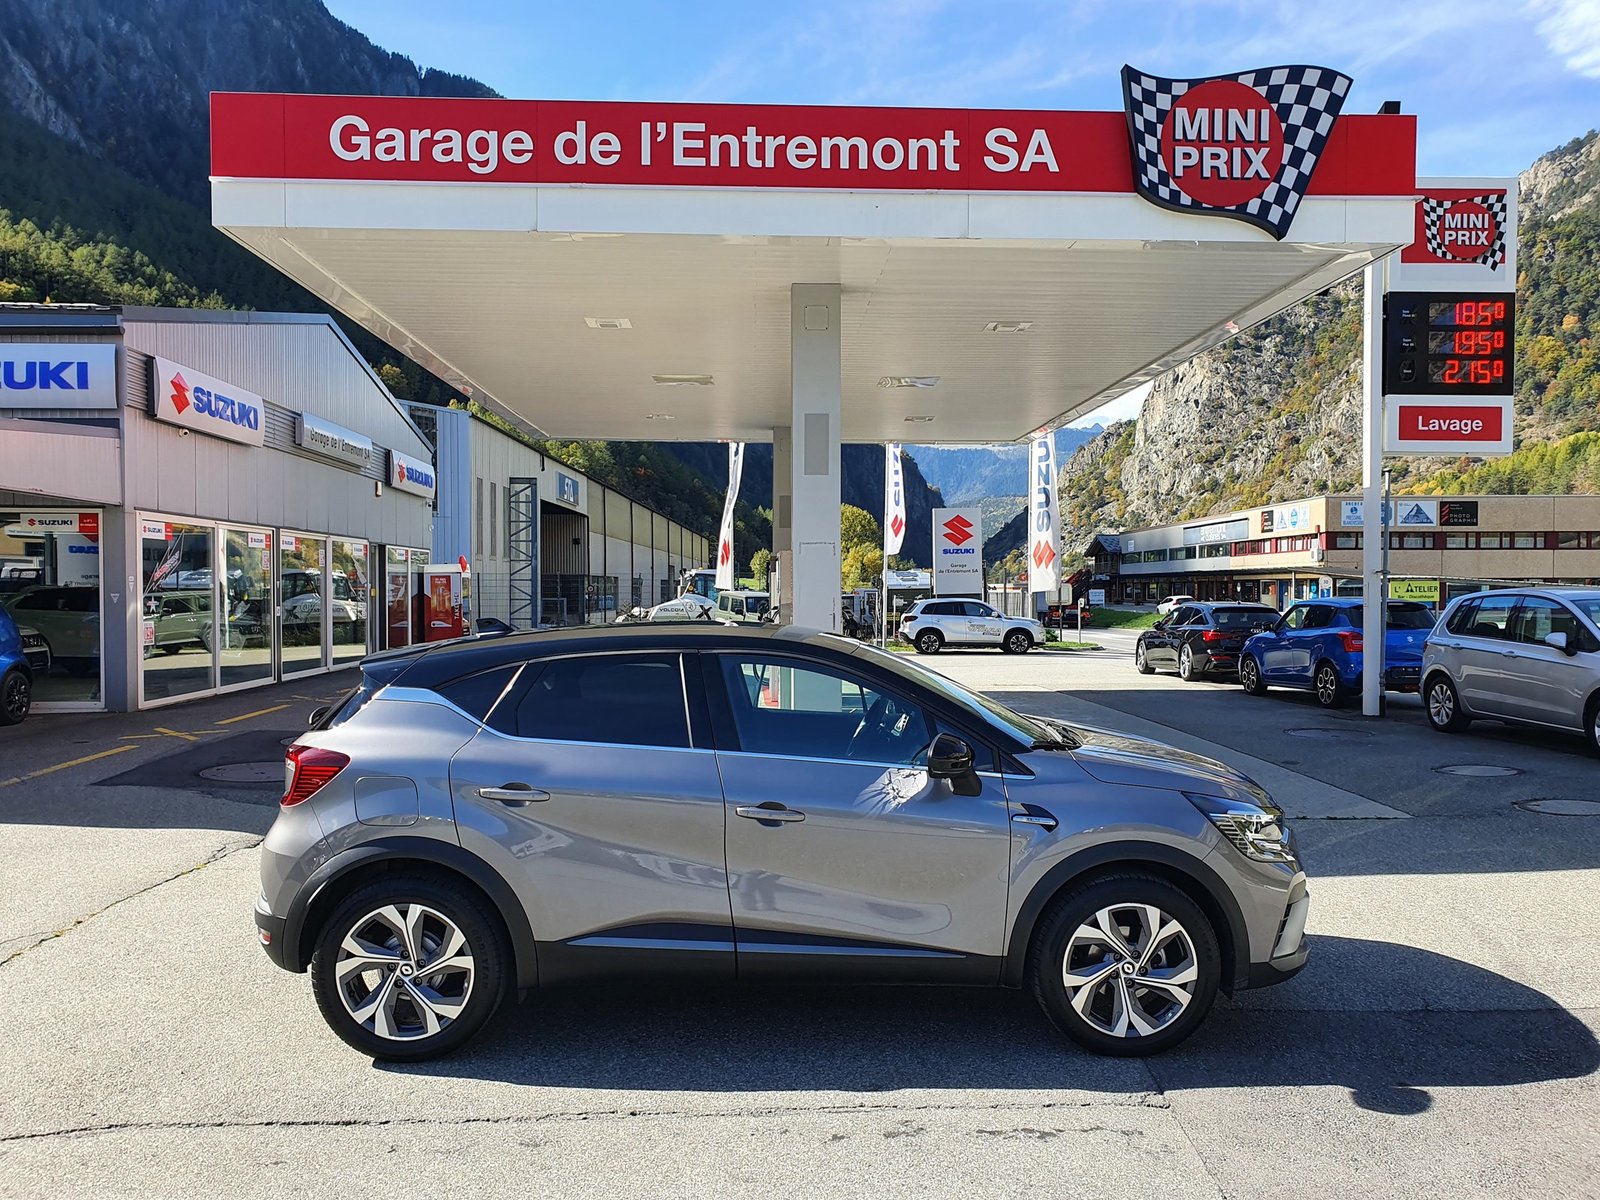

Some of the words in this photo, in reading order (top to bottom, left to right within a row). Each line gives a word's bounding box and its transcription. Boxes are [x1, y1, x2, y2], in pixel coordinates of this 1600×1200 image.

[1173, 107, 1270, 143] MINI
[328, 114, 534, 174] Garage
[553, 120, 621, 165] de
[640, 121, 960, 171] l’Entremont
[983, 127, 1060, 173] SA
[1173, 146, 1271, 180] PRIX
[1444, 213, 1489, 229] MINI
[1444, 230, 1489, 246] PRIX
[0, 361, 89, 390] UKI
[192, 386, 259, 431] SUZUKI
[1417, 415, 1483, 435] Lavage
[310, 427, 330, 449] Garage
[330, 435, 338, 451] de
[364, 447, 370, 460] SA
[406, 464, 433, 489] SUZUKI
